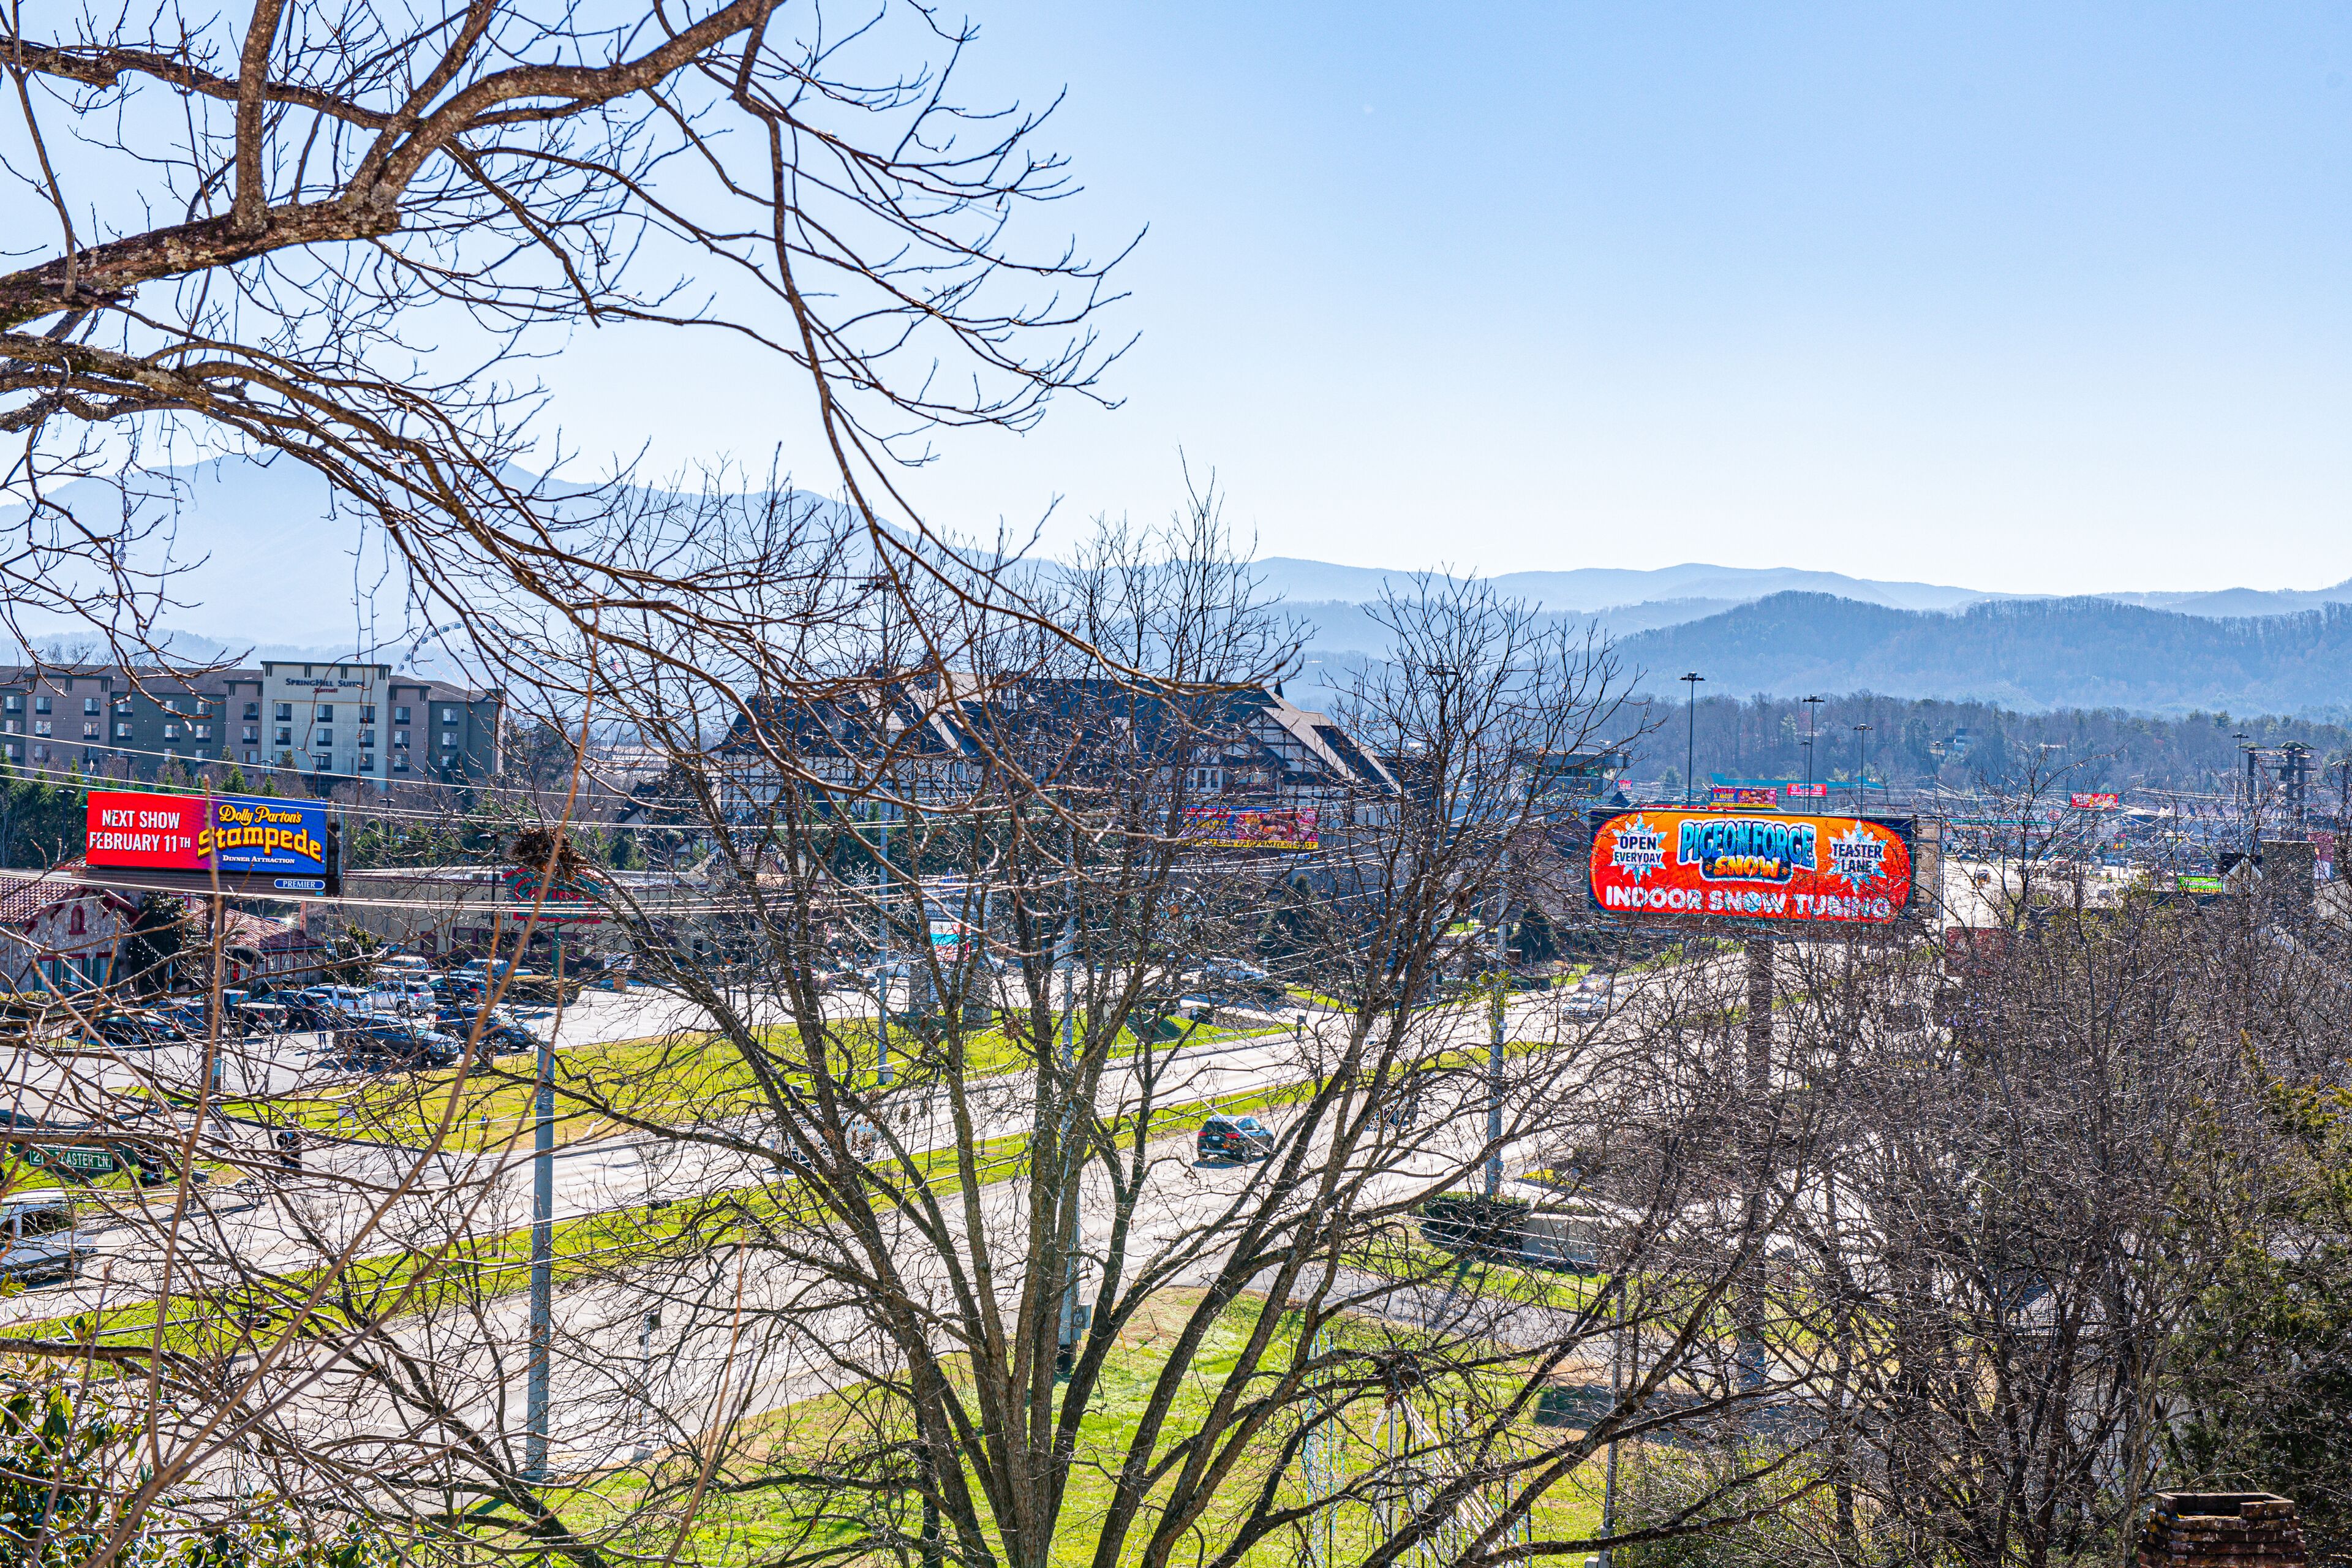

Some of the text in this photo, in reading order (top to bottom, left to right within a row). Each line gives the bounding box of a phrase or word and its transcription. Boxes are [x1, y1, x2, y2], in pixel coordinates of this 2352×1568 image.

[102, 809, 181, 829] NEXT SHOW
[218, 804, 302, 826] Dolly Parton's
[89, 831, 160, 851] FEBRUARY
[197, 826, 323, 863] Stampede
[1619, 836, 1657, 850] OPEN
[1679, 821, 1815, 869] PIGEON FORGE
[251, 856, 295, 864] ATTRACTION
[1614, 851, 1662, 863] EVERYDAY
[1832, 843, 1882, 860] TEASTER
[1713, 855, 1781, 878] SNOW
[1841, 859, 1872, 873] LANE
[1606, 885, 1891, 919] INDOOR SNOW TUBING
[55, 1152, 94, 1167] TEASTER
[97, 1155, 111, 1168] LN.
